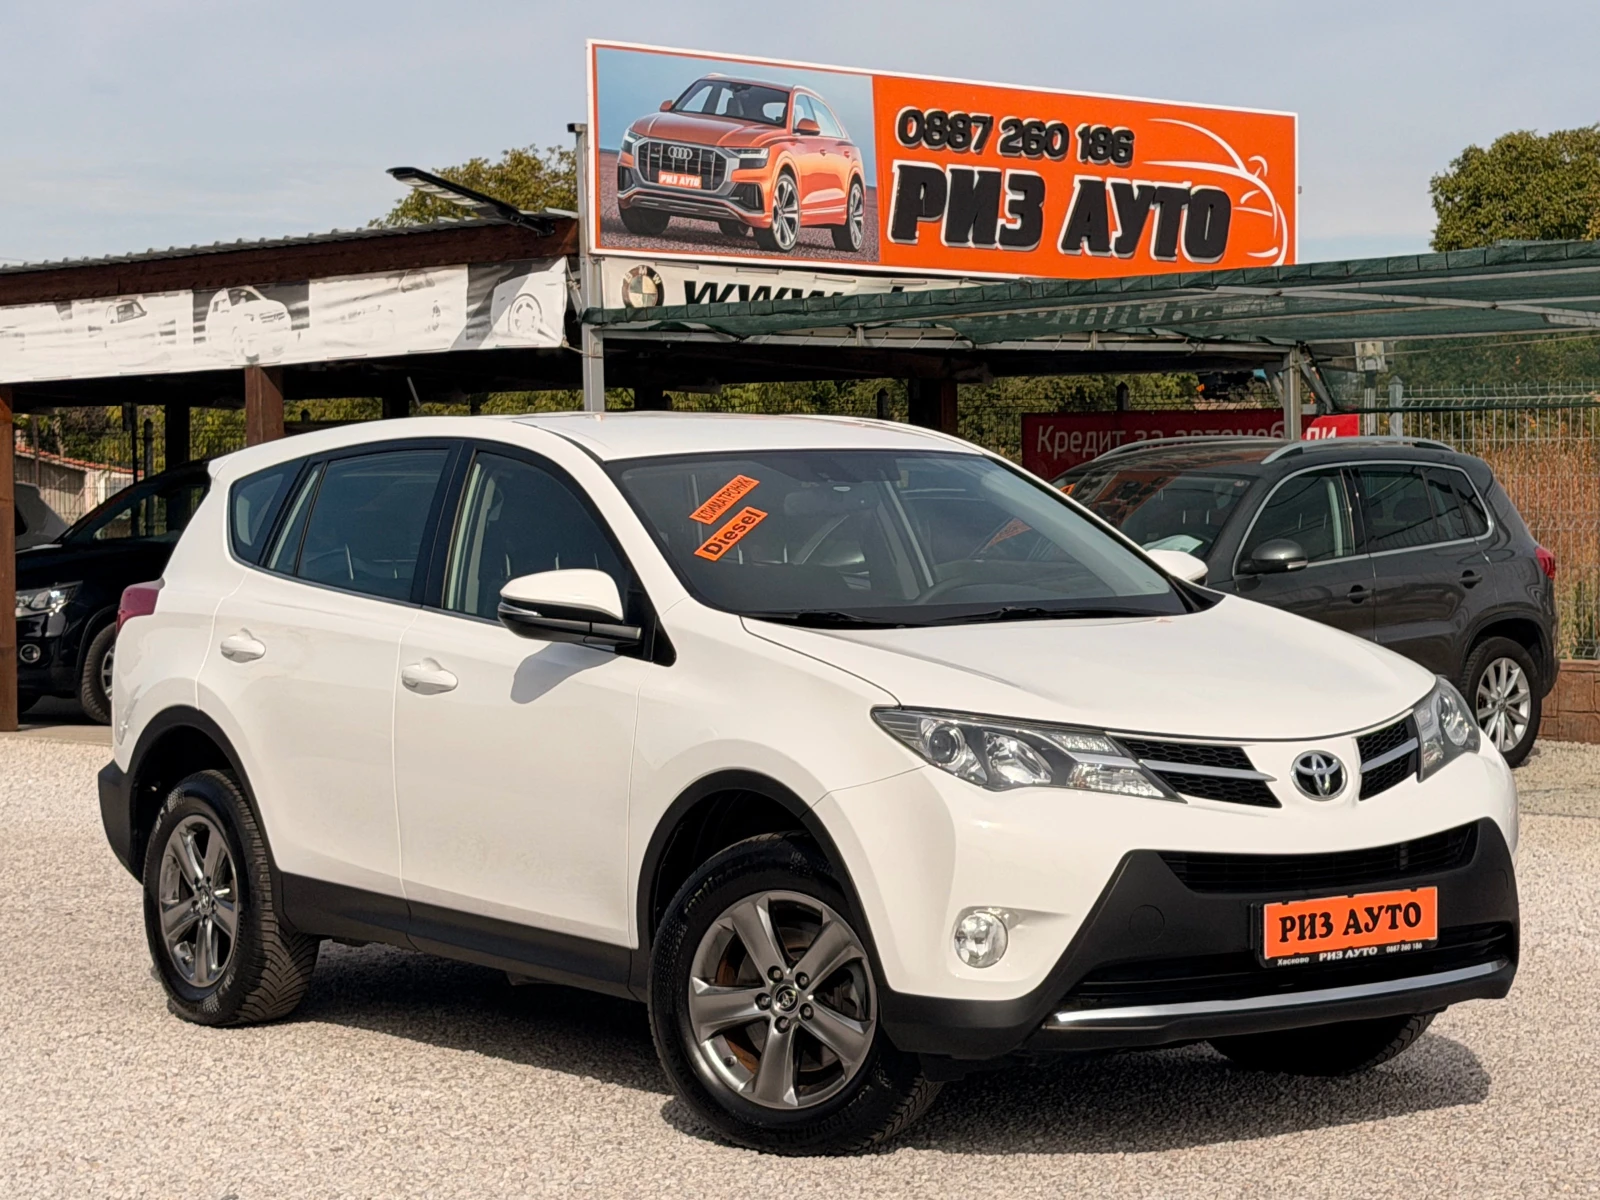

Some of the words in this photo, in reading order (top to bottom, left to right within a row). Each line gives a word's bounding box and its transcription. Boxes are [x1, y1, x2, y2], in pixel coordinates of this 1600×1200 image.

[895, 106, 994, 154] 0887
[997, 115, 1069, 160] 260
[1075, 123, 1135, 166] 186
[660, 173, 677, 184] РИЗ
[679, 175, 701, 187] АУТО
[888, 160, 1046, 251] РИЗ
[1057, 175, 1232, 263] АУТО
[623, 265, 662, 284] BMW
[1037, 424, 1126, 460] Кредит
[702, 509, 762, 555] Diesel
[1279, 912, 1334, 942] РИЗ
[1342, 902, 1422, 936] АУТО
[1277, 955, 1310, 967] Хасково
[1319, 950, 1344, 961] РИЗ
[1345, 946, 1378, 958] АУТО
